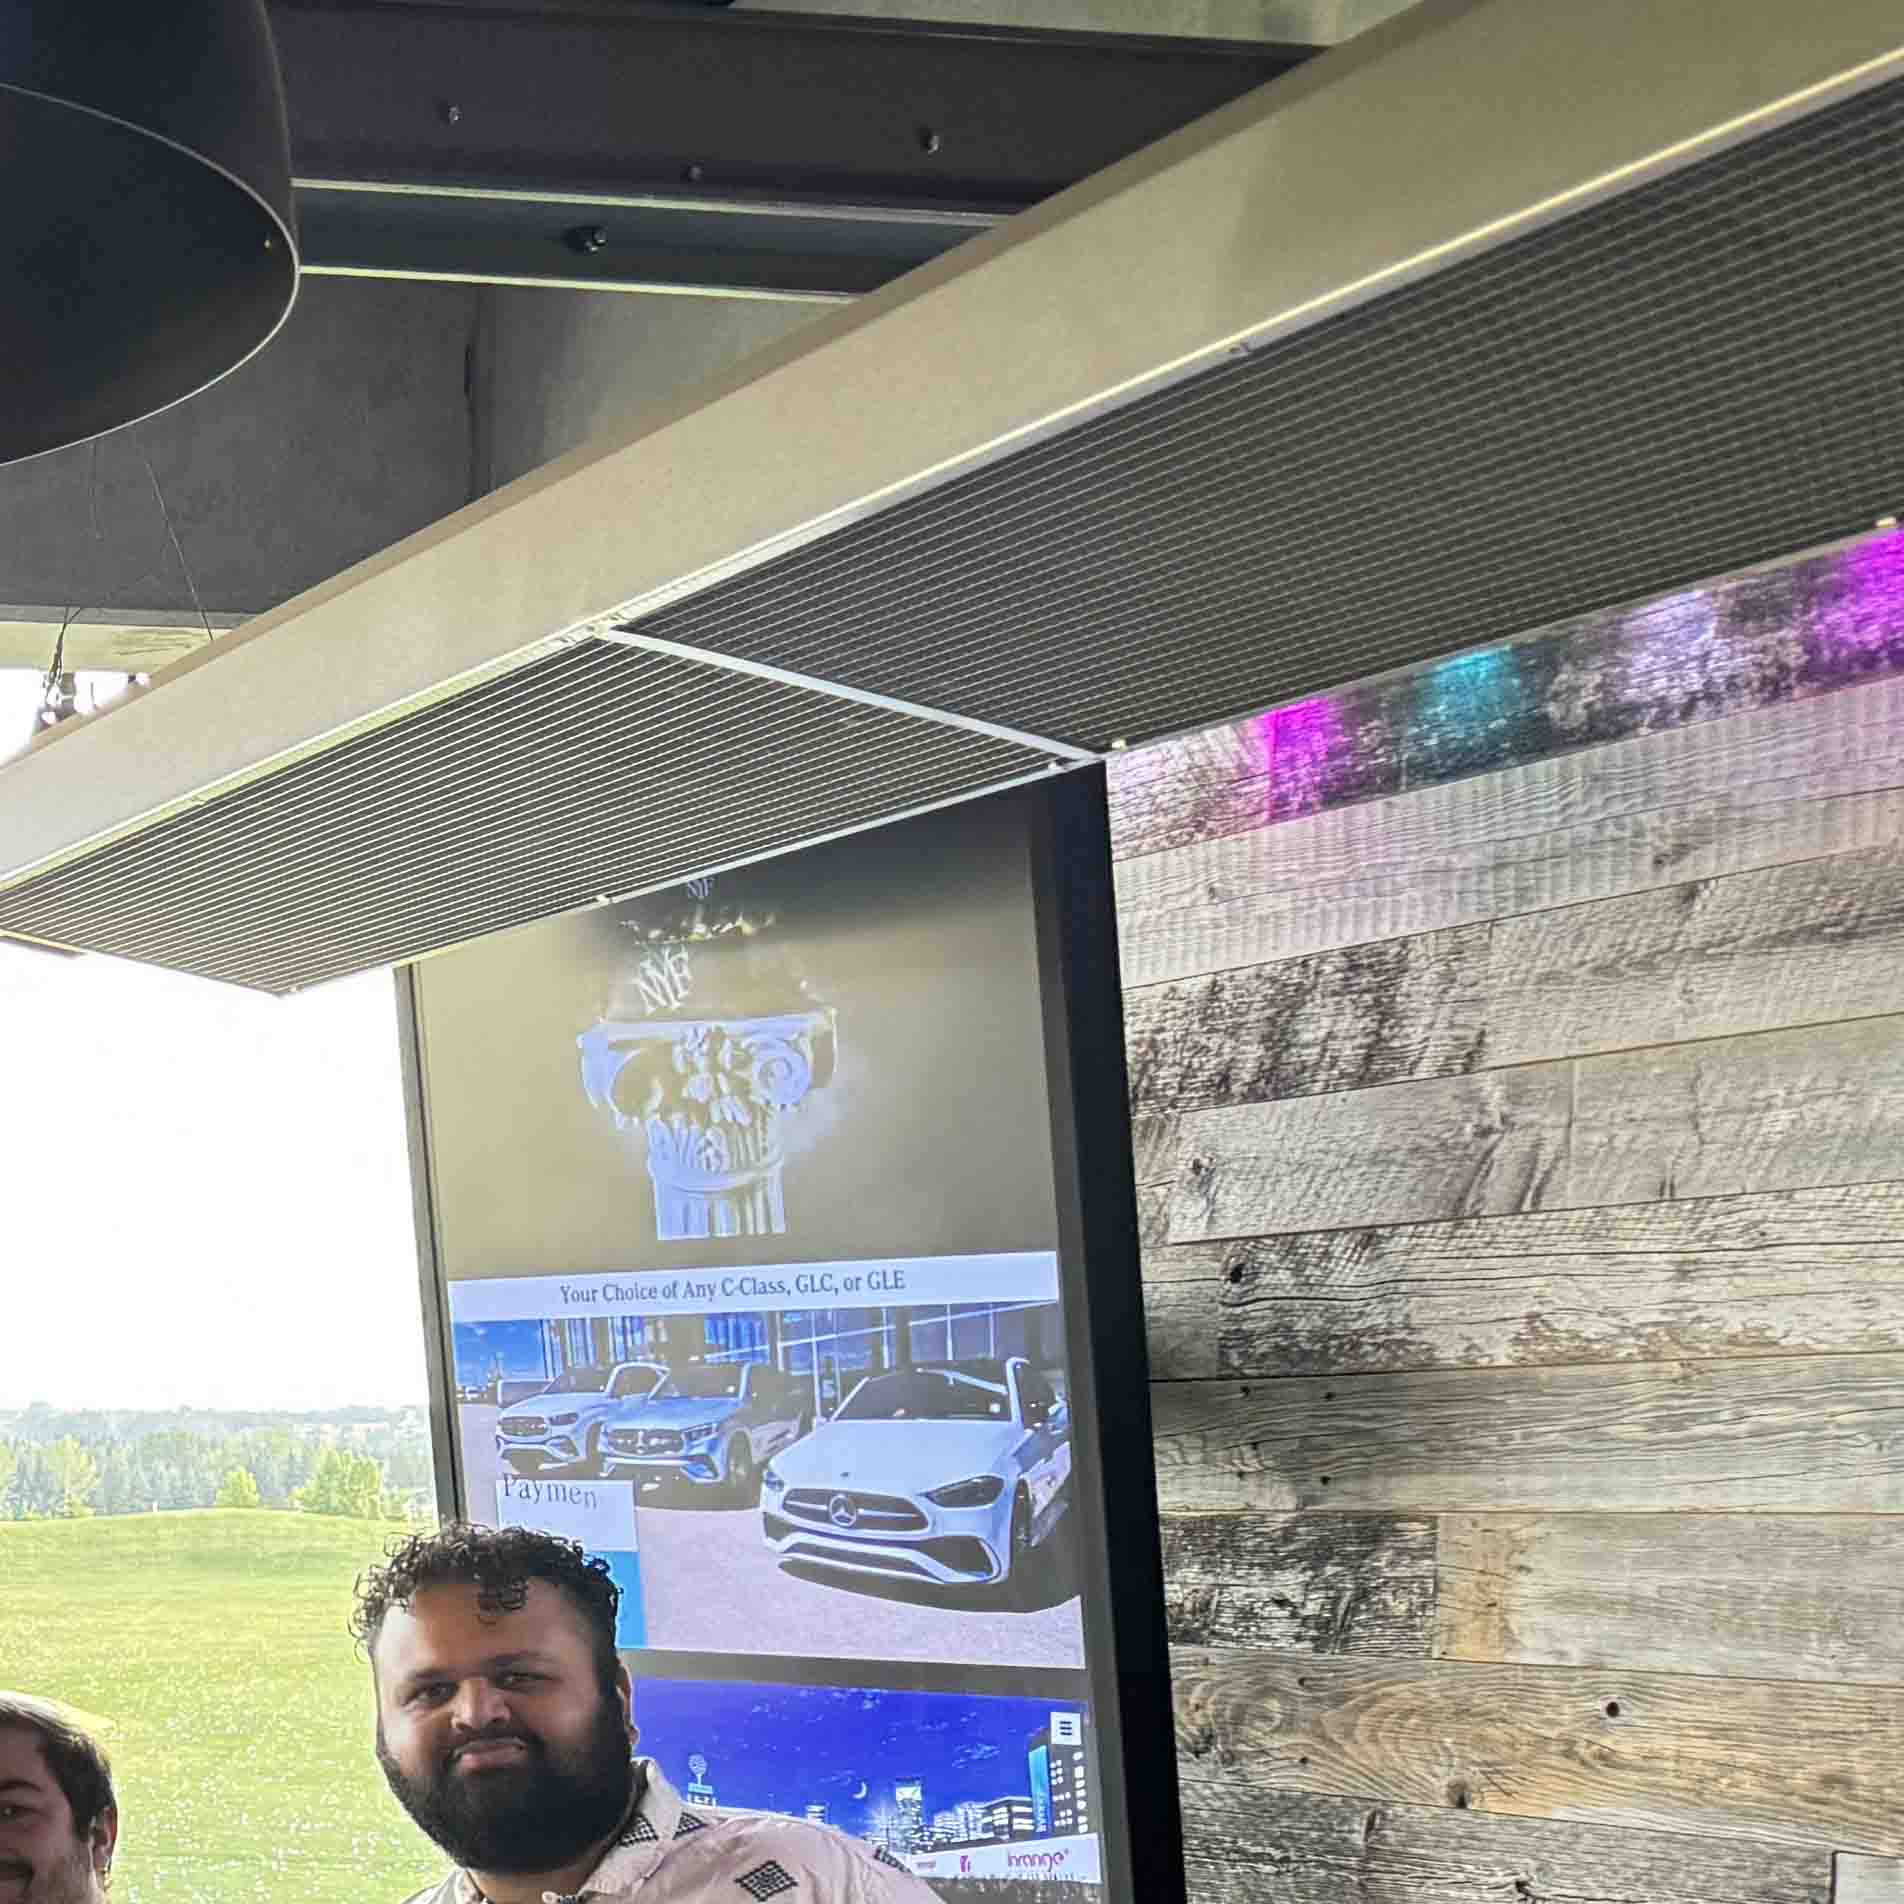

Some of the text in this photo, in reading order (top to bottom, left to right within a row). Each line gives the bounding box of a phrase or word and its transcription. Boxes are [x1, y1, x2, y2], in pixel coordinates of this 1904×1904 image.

[560, 1270, 907, 1305] Your Choice of Any C-Class, GLC, or GLE
